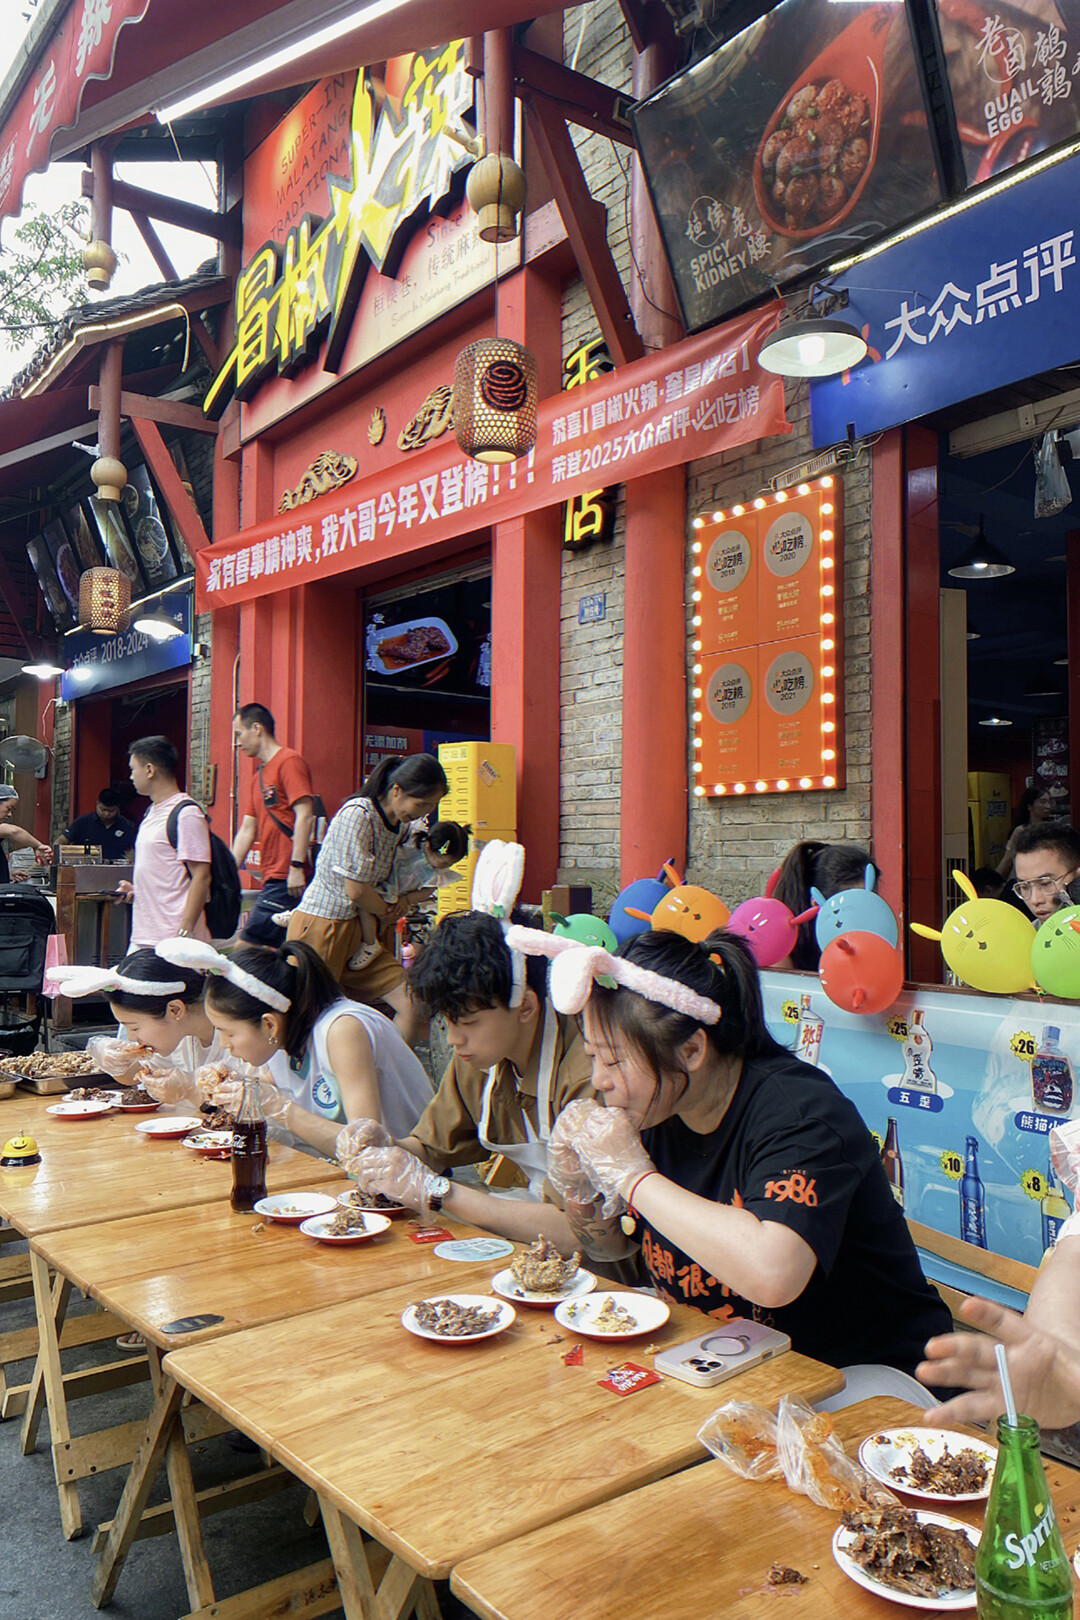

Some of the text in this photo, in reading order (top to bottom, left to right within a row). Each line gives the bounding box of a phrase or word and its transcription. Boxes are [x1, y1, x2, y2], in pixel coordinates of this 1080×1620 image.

[984, 79, 1040, 120] QUAIL
[281, 72, 346, 174] SUPER-IN
[987, 106, 1024, 138] EGG
[271, 138, 348, 240] TRADITIONA
[690, 239, 730, 276] SPICY
[695, 250, 747, 293] KIDNEY
[885, 230, 1076, 360] 大众点评
[720, 568, 735, 578] 2018
[779, 551, 796, 562] 2020
[101, 631, 149, 664] 2018-2024
[721, 701, 736, 710] 2019
[780, 692, 796, 701] 2021
[1014, 1038, 1035, 1055] ¥26
[944, 1157, 960, 1173] ¥10
[764, 1173, 818, 1207] 1986
[1027, 1176, 1040, 1192] ¥8
[1005, 1504, 1056, 1569] Sprit
